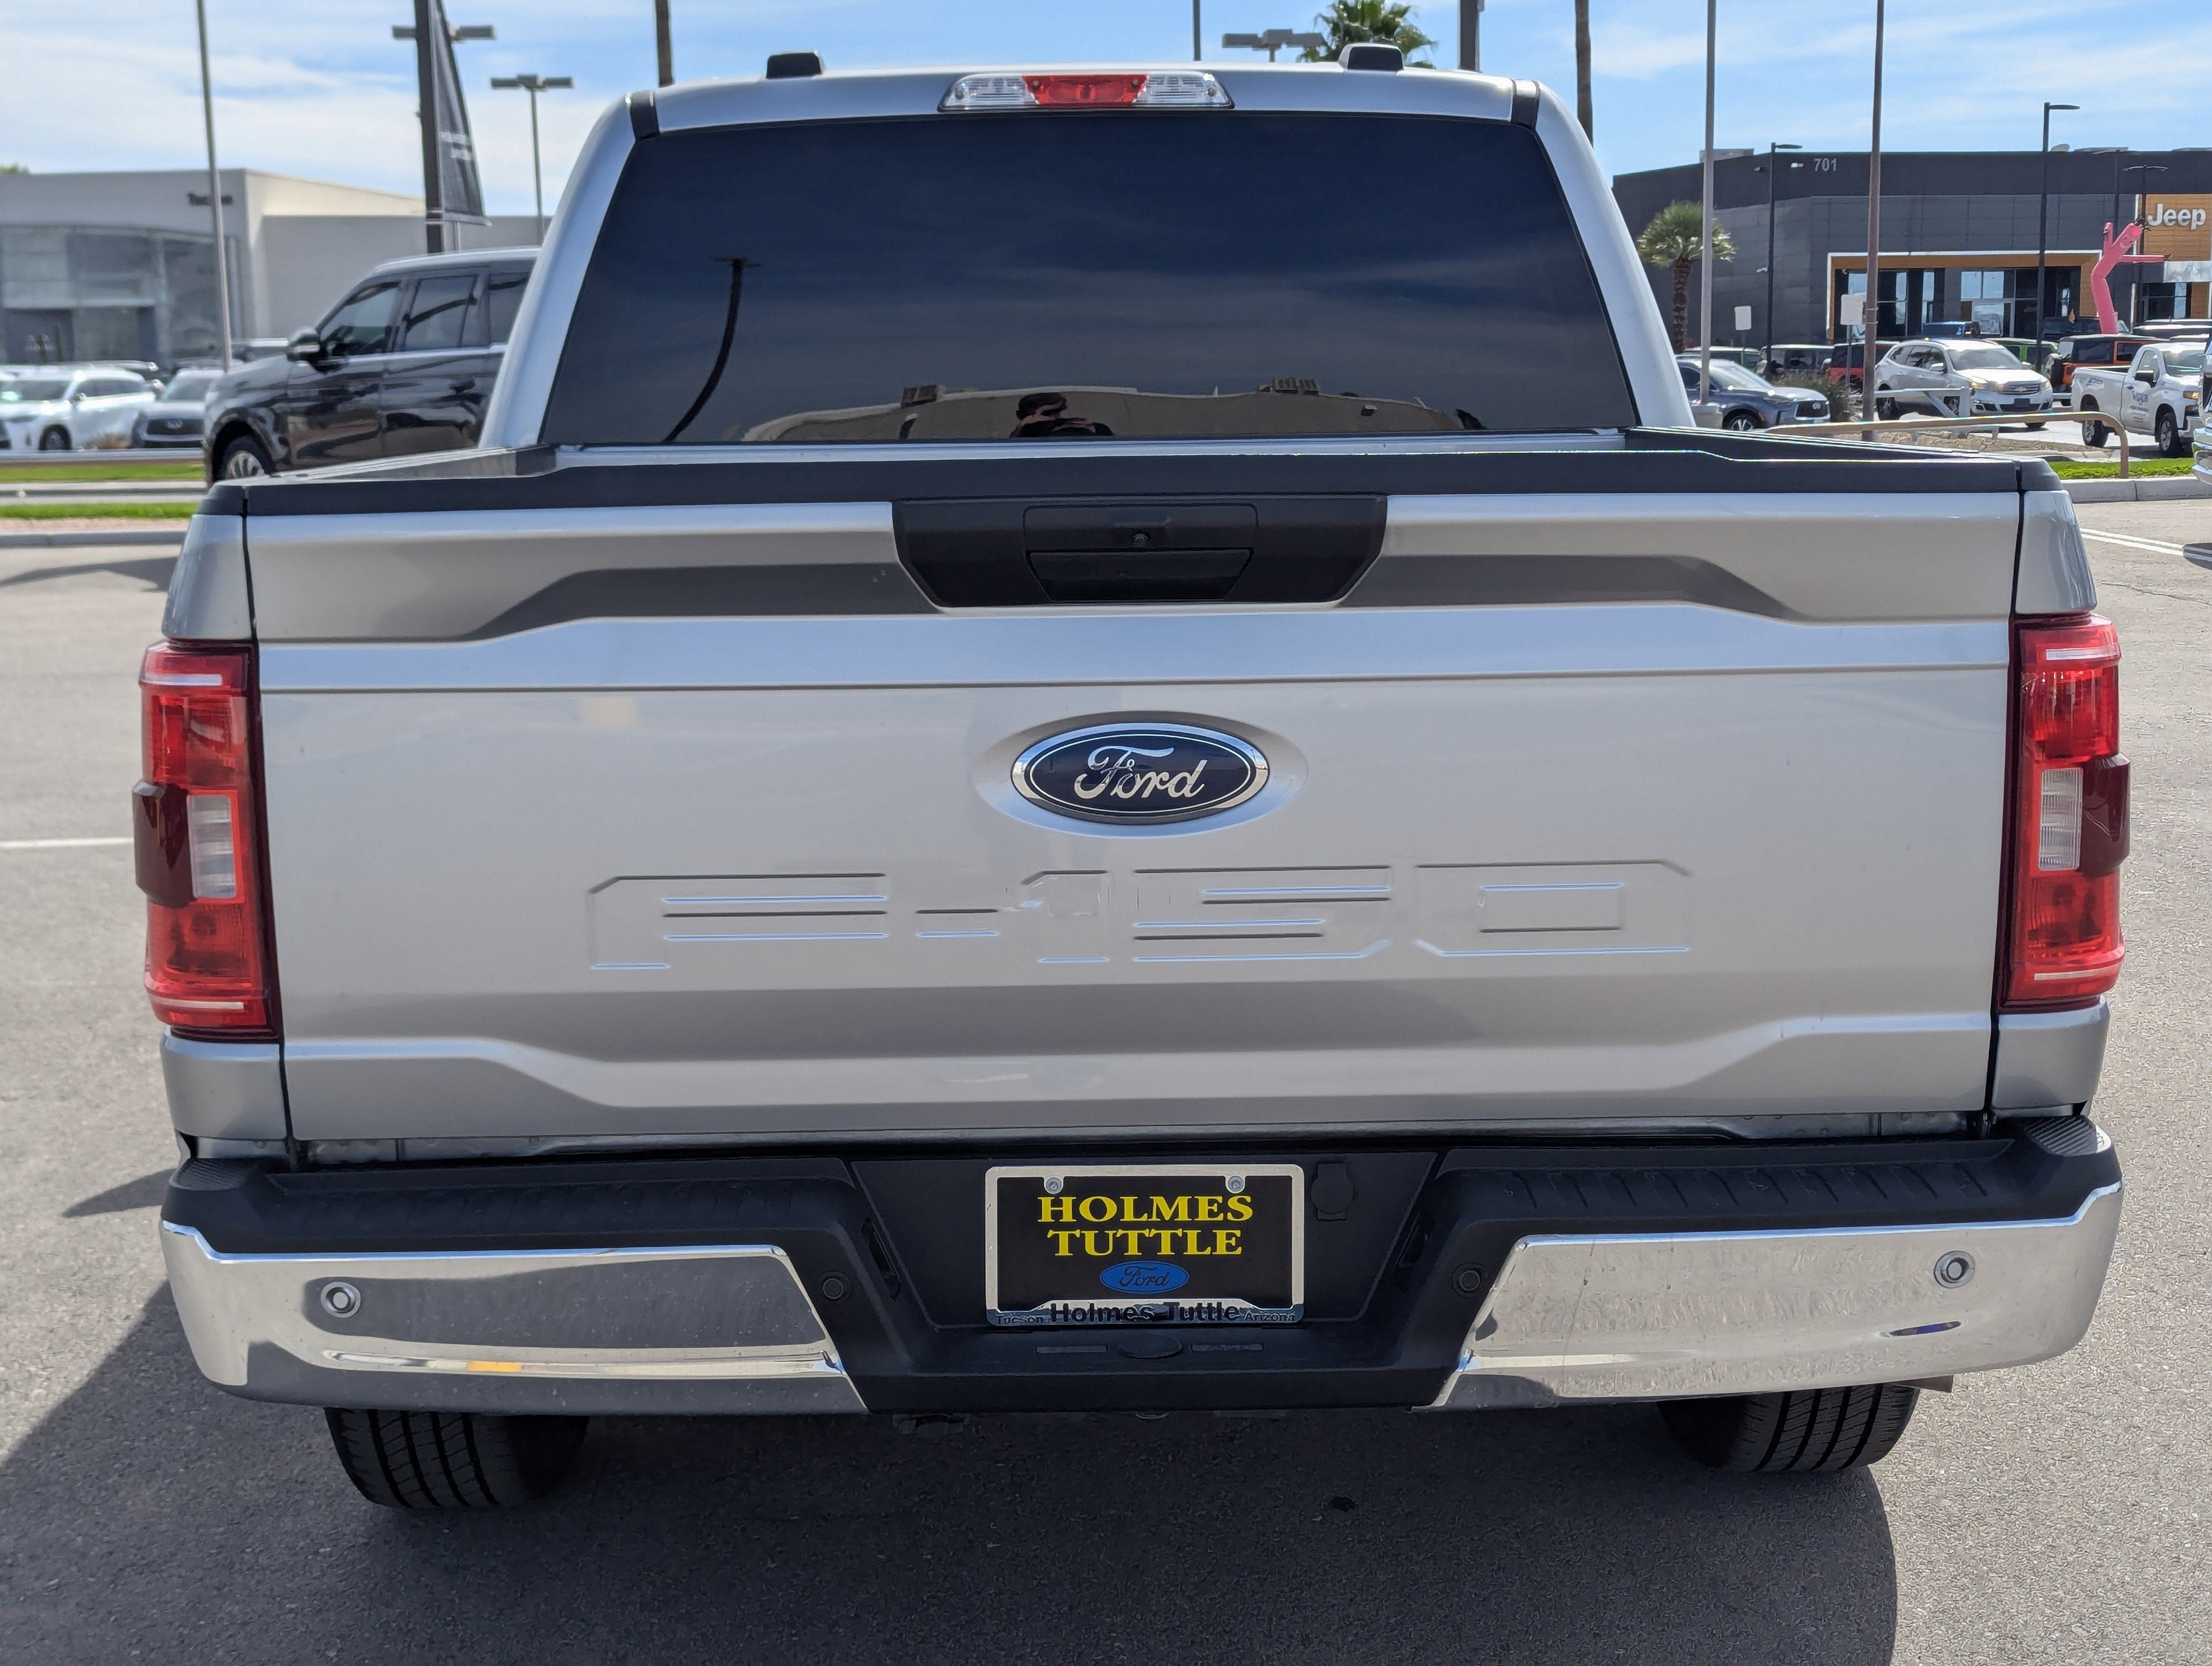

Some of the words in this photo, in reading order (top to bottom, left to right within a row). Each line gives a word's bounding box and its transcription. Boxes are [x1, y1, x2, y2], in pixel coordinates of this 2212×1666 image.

[1813, 158, 1837, 172] 701
[2147, 203, 2206, 230] Jeep
[1073, 745, 1208, 799] Ford
[588, 860, 1692, 971] F-150
[1037, 1195, 1253, 1222] HOLMES
[1047, 1228, 1243, 1257] TUTTLE
[1118, 1265, 1171, 1288] Ford
[1051, 1303, 1155, 1323] Holmes
[1163, 1301, 1239, 1322] Tuttle
